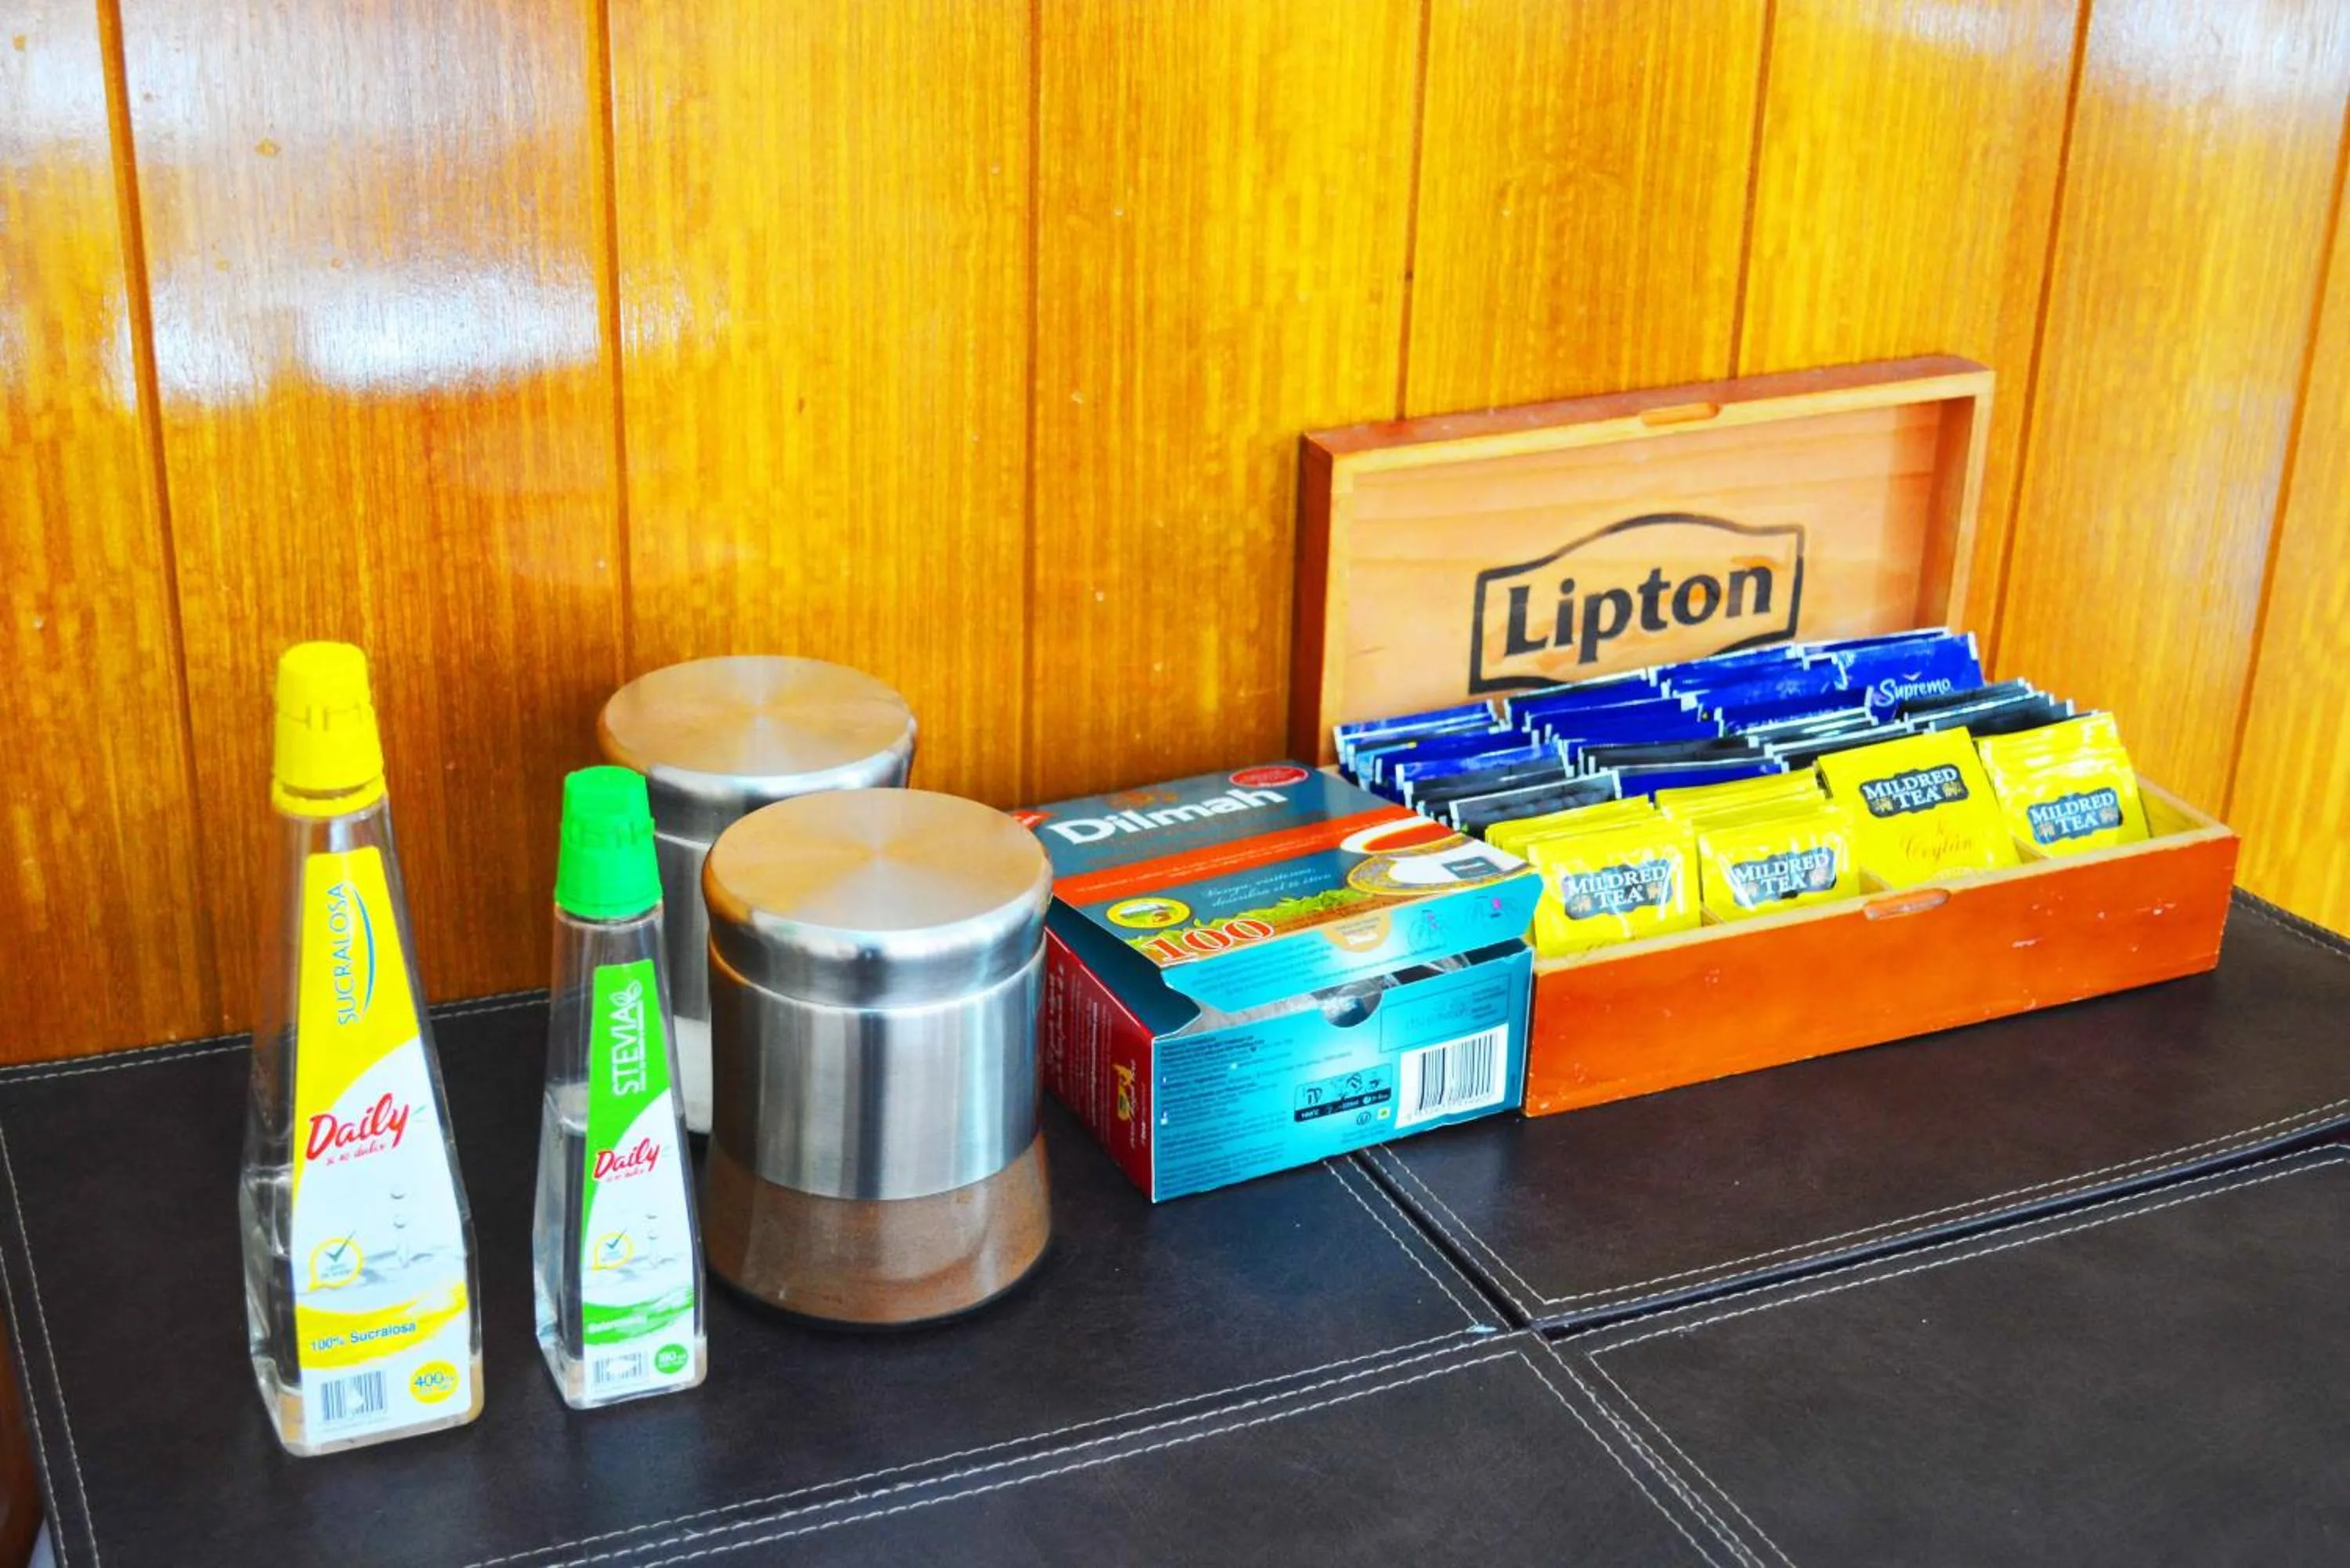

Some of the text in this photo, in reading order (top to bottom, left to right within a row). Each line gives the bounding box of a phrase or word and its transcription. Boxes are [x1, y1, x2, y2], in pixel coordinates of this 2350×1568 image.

[1503, 565, 1773, 665] Lipton
[1874, 677, 1953, 707] Supremo
[1862, 767, 1958, 801] MILDRED
[1892, 786, 1943, 809] TEA
[1047, 788, 1289, 845] Dilmah
[2030, 791, 2115, 825] MILDRED
[2055, 811, 2099, 834] TEA
[1567, 865, 1667, 895] MILDRED
[1733, 849, 1829, 883] MILDRED
[1761, 871, 1807, 894] TEA
[1594, 884, 1645, 909] TEA
[327, 882, 356, 1027] SUCRALOSA
[1142, 918, 1275, 963] 100
[609, 1003, 640, 1097] STEVIA
[306, 1092, 410, 1160] Daily
[593, 1136, 661, 1180] Daily
[311, 1322, 417, 1351] 100% Sucralosa
[414, 1371, 444, 1387] 400
